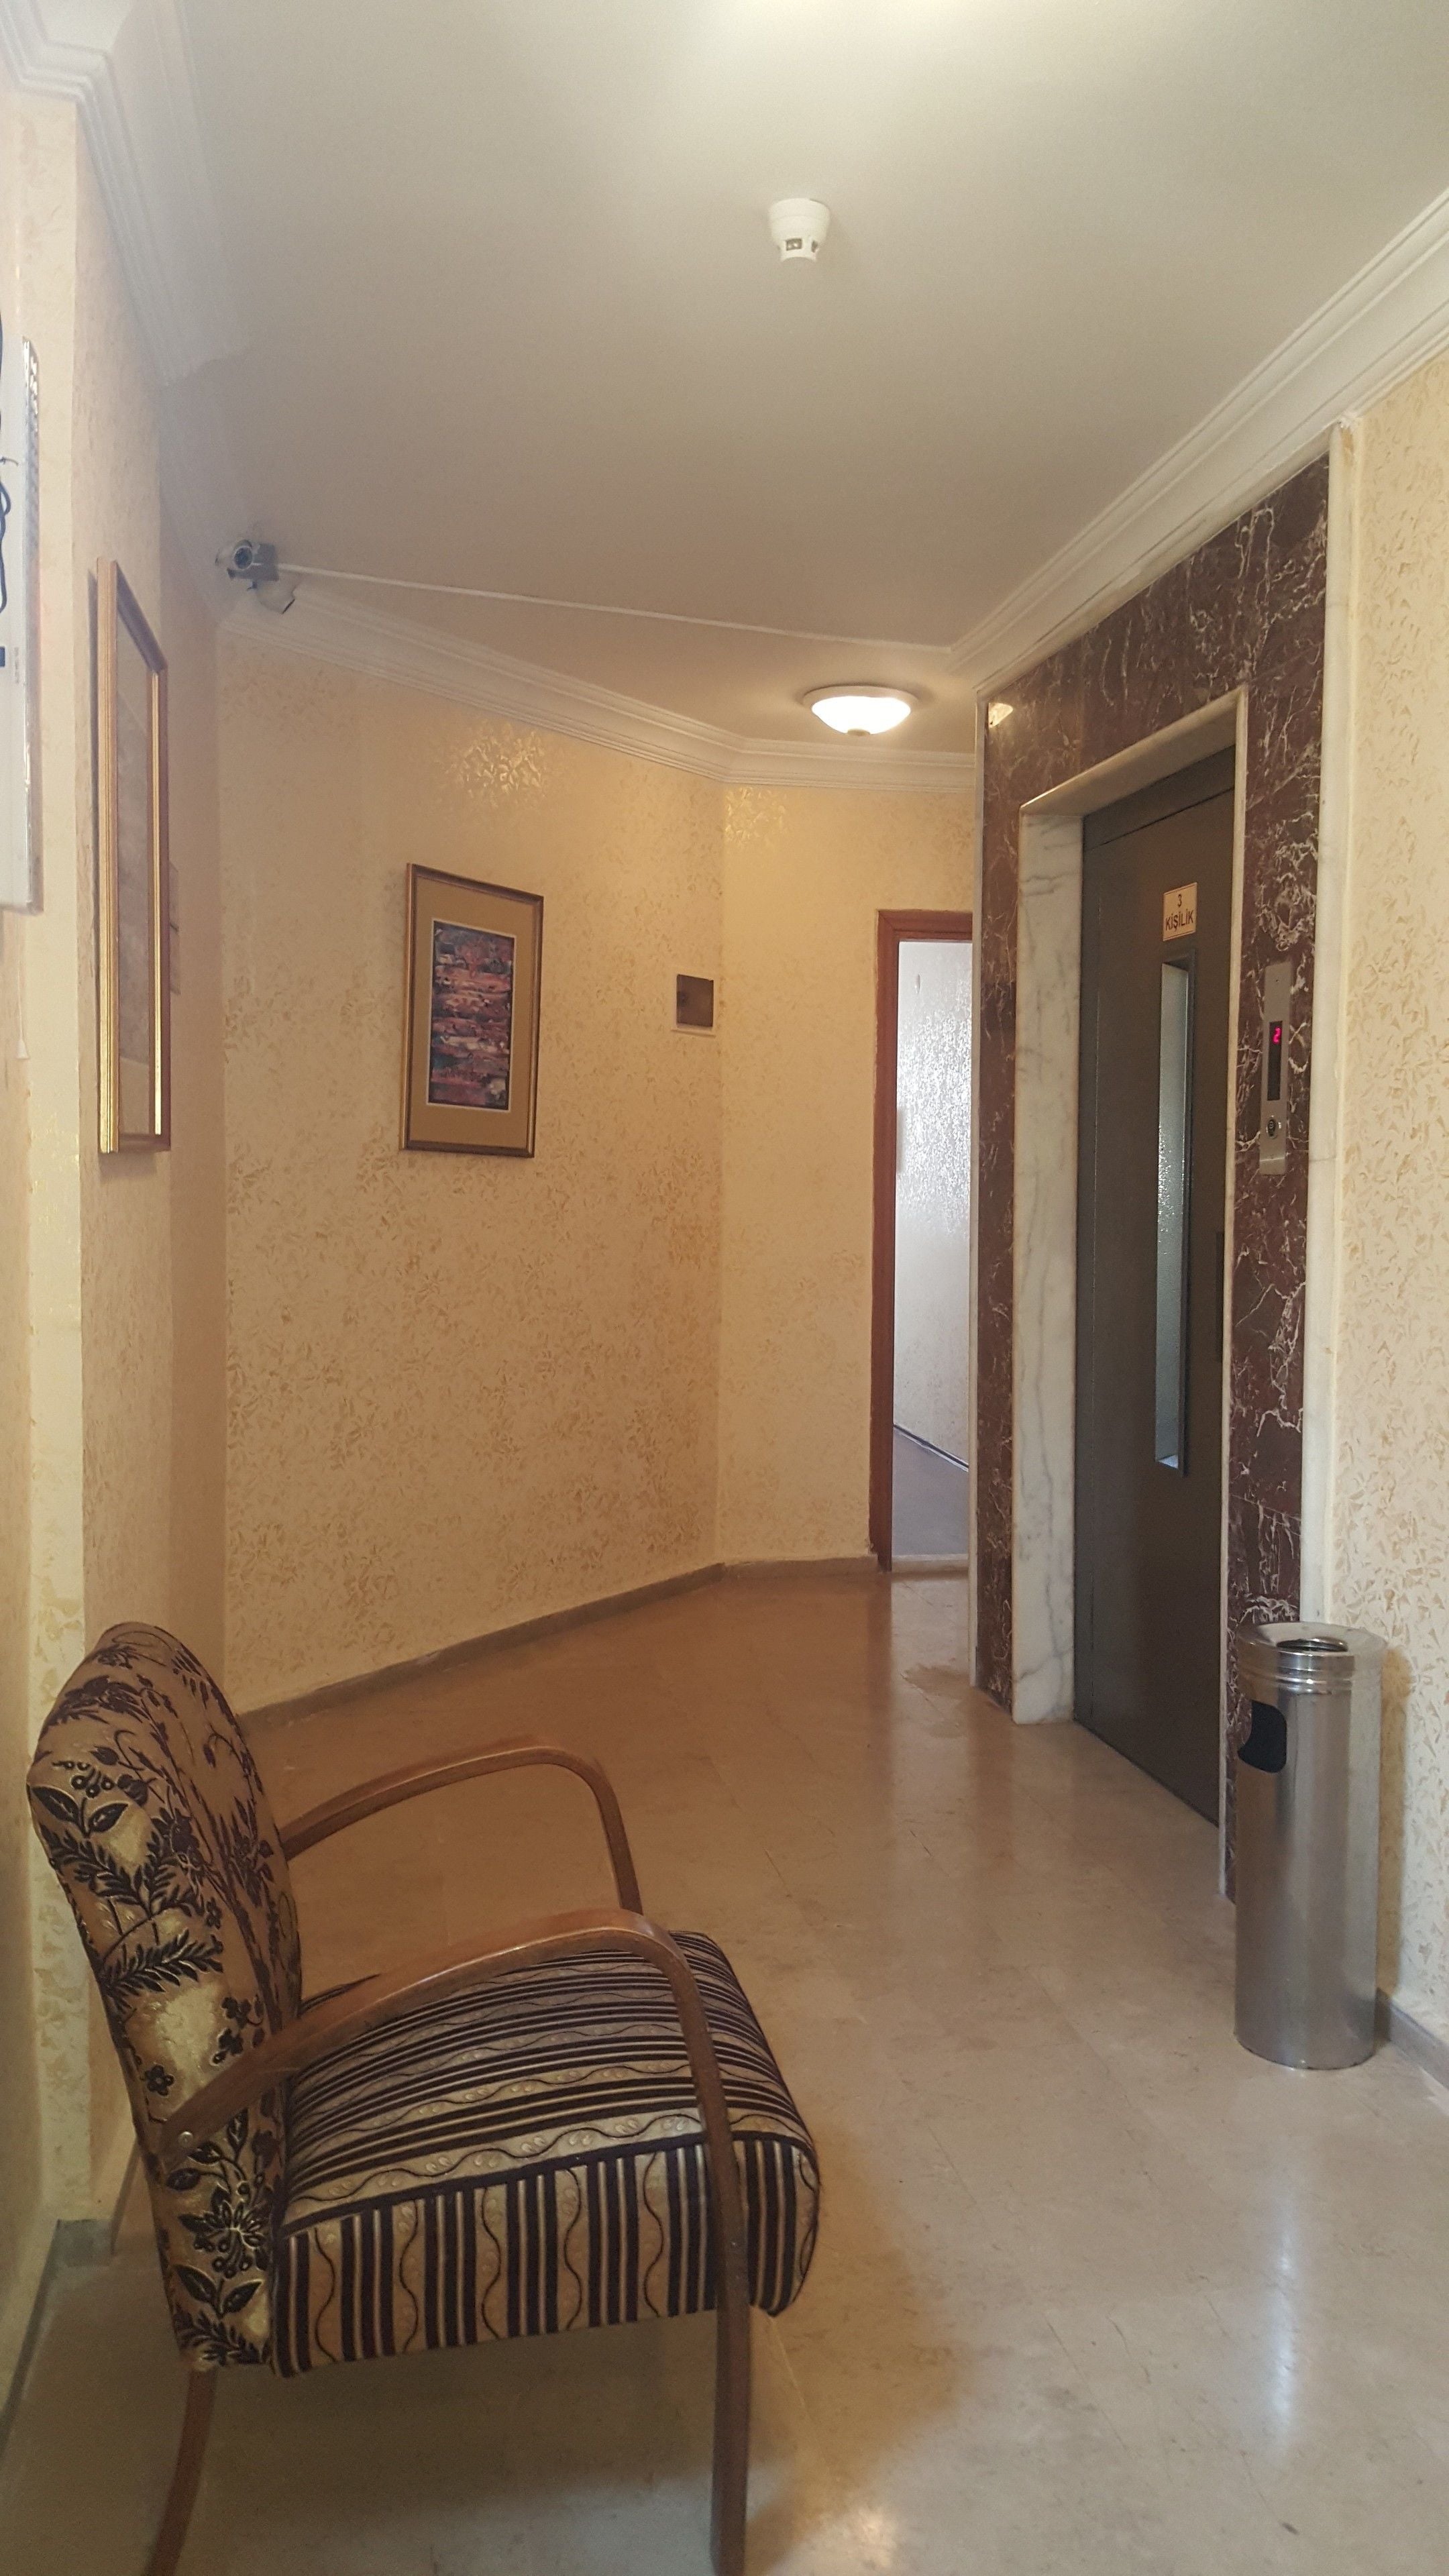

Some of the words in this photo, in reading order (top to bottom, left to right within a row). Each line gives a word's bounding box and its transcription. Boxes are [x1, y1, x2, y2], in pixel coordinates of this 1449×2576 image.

[1177, 894, 1182, 908] 3
[1165, 909, 1194, 931] KİŞİLİK
[1273, 1027, 1281, 1043] 2
